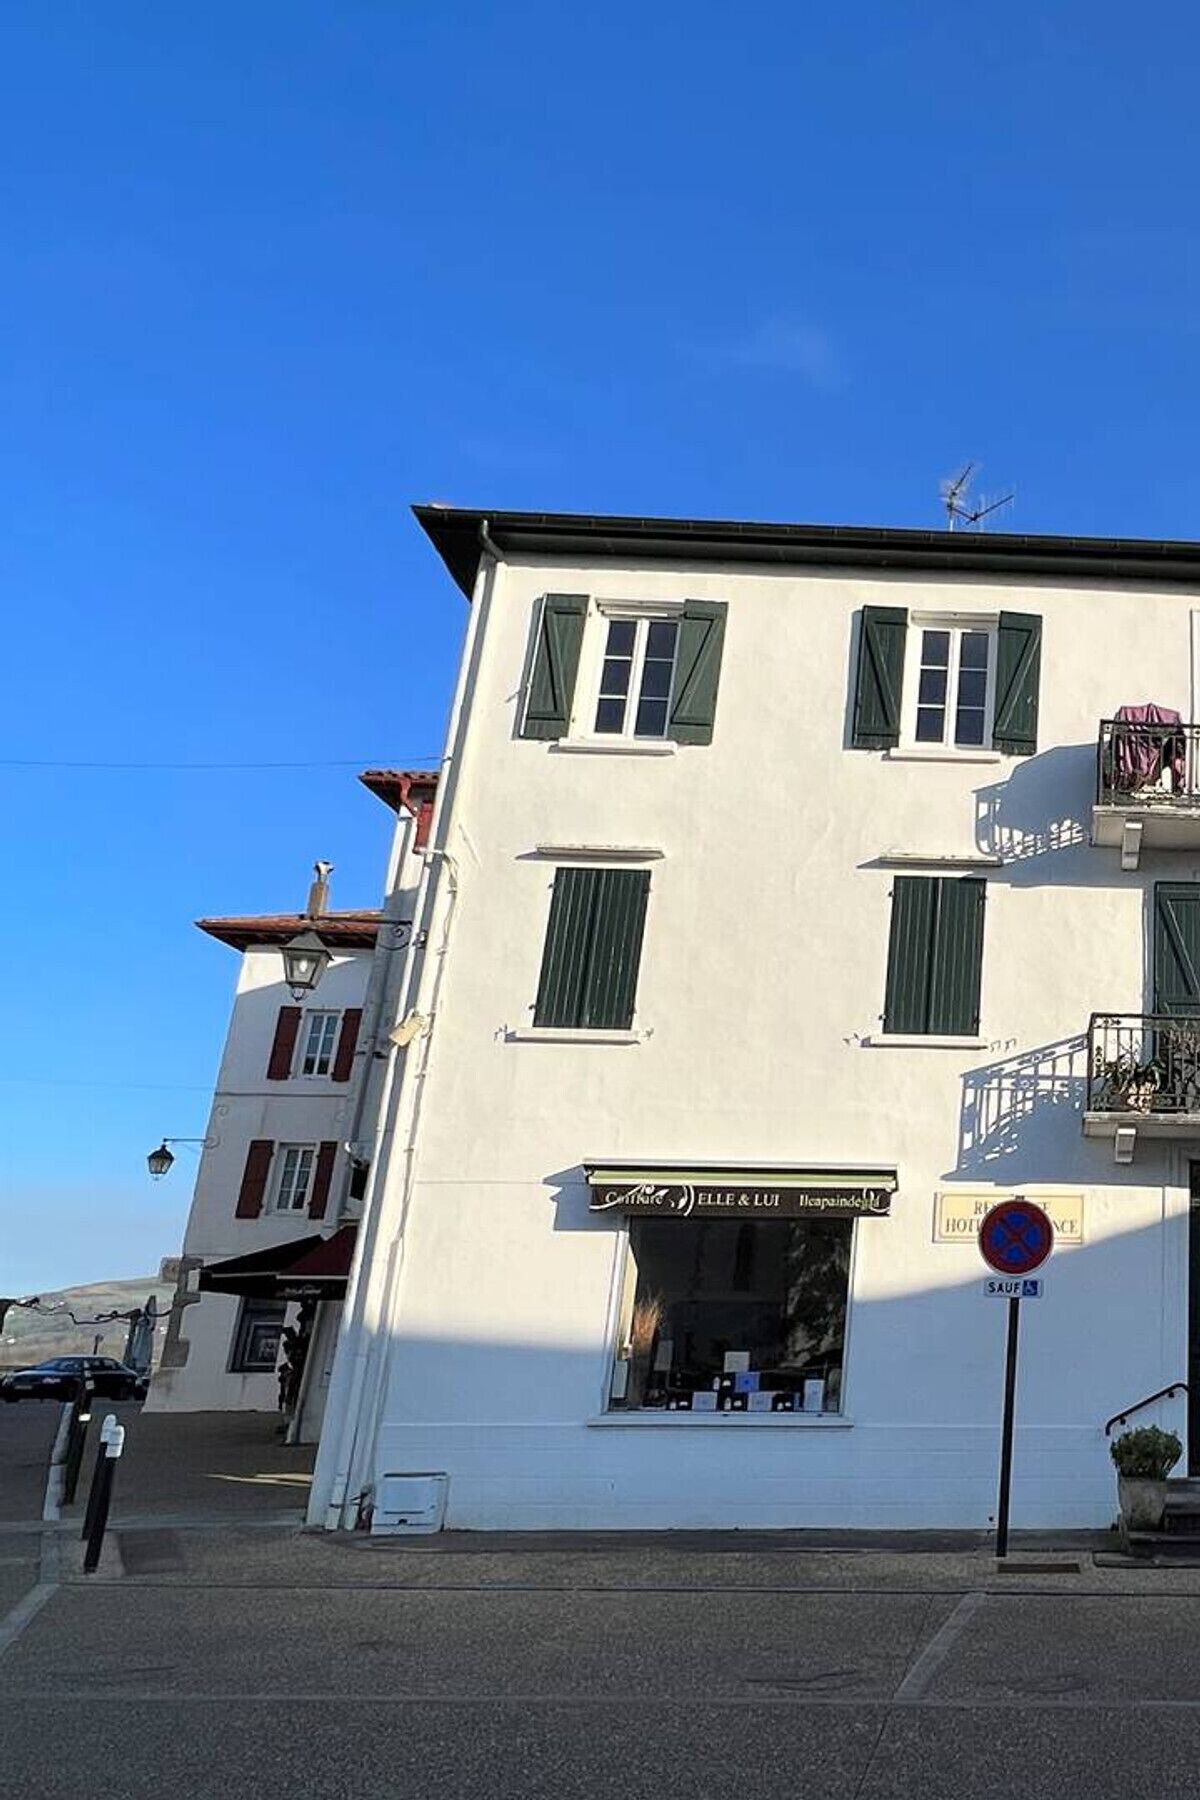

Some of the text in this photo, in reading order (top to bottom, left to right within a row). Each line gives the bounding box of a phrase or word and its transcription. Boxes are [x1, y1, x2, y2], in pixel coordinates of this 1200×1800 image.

[698, 1193, 736, 1207] ELLE
[738, 1193, 751, 1207] &
[754, 1193, 780, 1208] LUI
[988, 1281, 1021, 1293] SAUF
